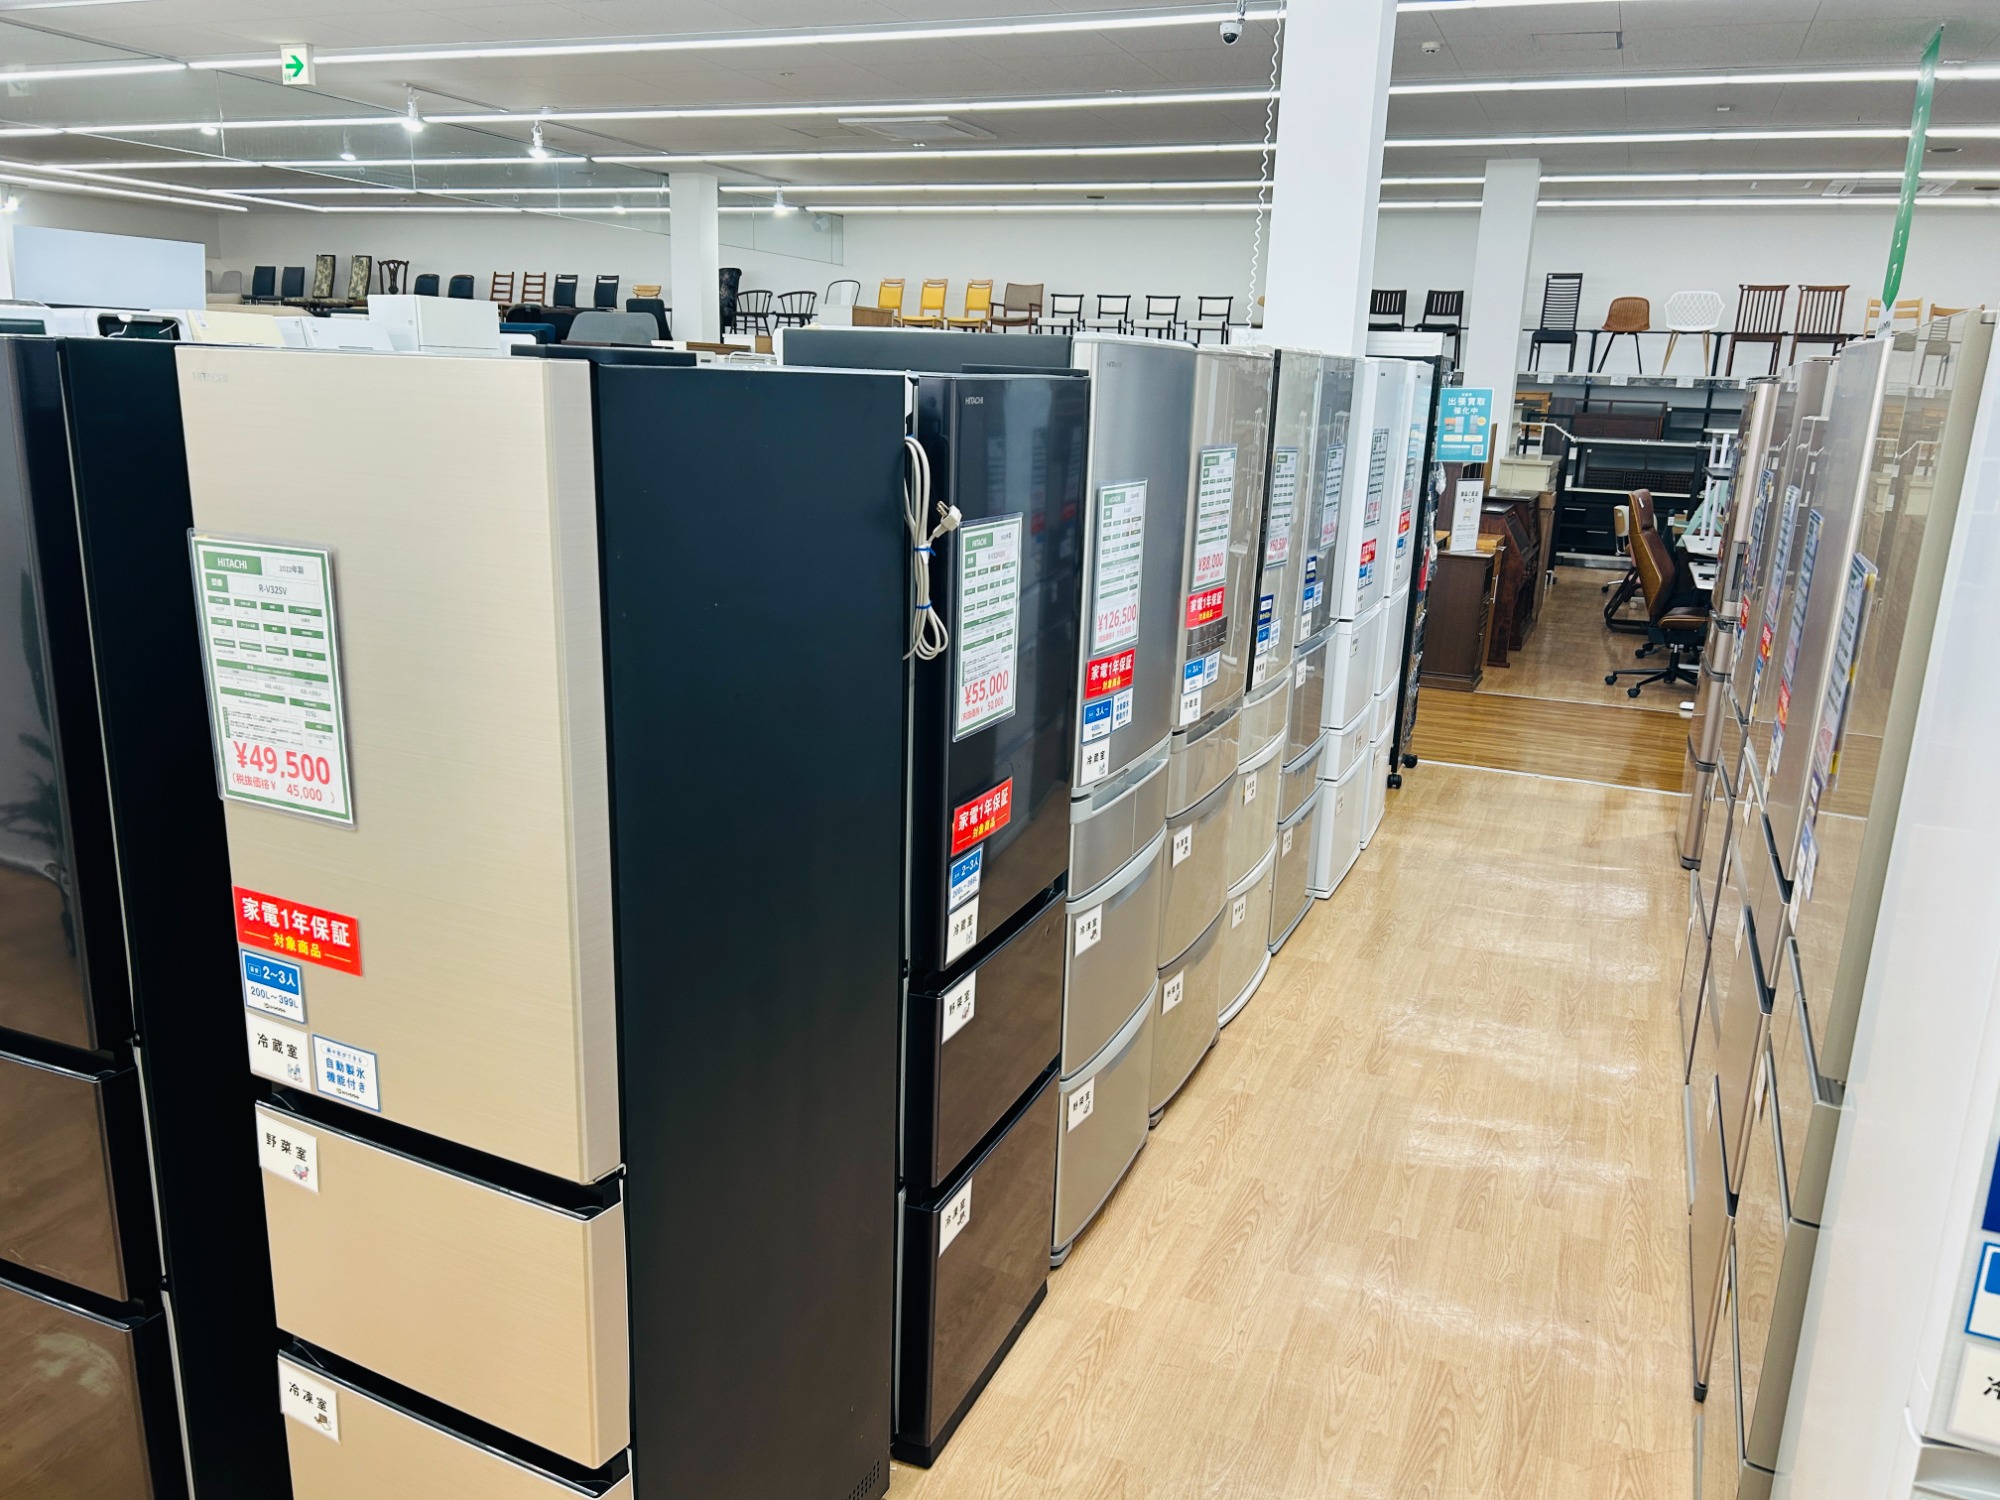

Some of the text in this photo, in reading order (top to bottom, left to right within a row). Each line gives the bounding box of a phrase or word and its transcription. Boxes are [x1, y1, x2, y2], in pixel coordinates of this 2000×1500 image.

[965, 396, 984, 405] HITACHI
[217, 557, 248, 570] HITACHI
[1098, 603, 1137, 632] ¥126,500
[1091, 653, 1133, 681] 家電1年保証
[965, 670, 1009, 707] ¥55,000
[233, 741, 330, 785] ¥49,500
[286, 783, 322, 802] 45,000
[958, 786, 1009, 831] 家電1年保証
[242, 897, 351, 948] 家電1年保証
[273, 932, 322, 959] 対象商品
[949, 989, 970, 1016] 野菜室
[257, 1033, 298, 1060] 冷蔵室
[325, 1057, 366, 1080] 自動製氷
[326, 1071, 365, 1093] 機能付き
[266, 1132, 307, 1162] 野菜室
[289, 1381, 327, 1413] 冷凍室
